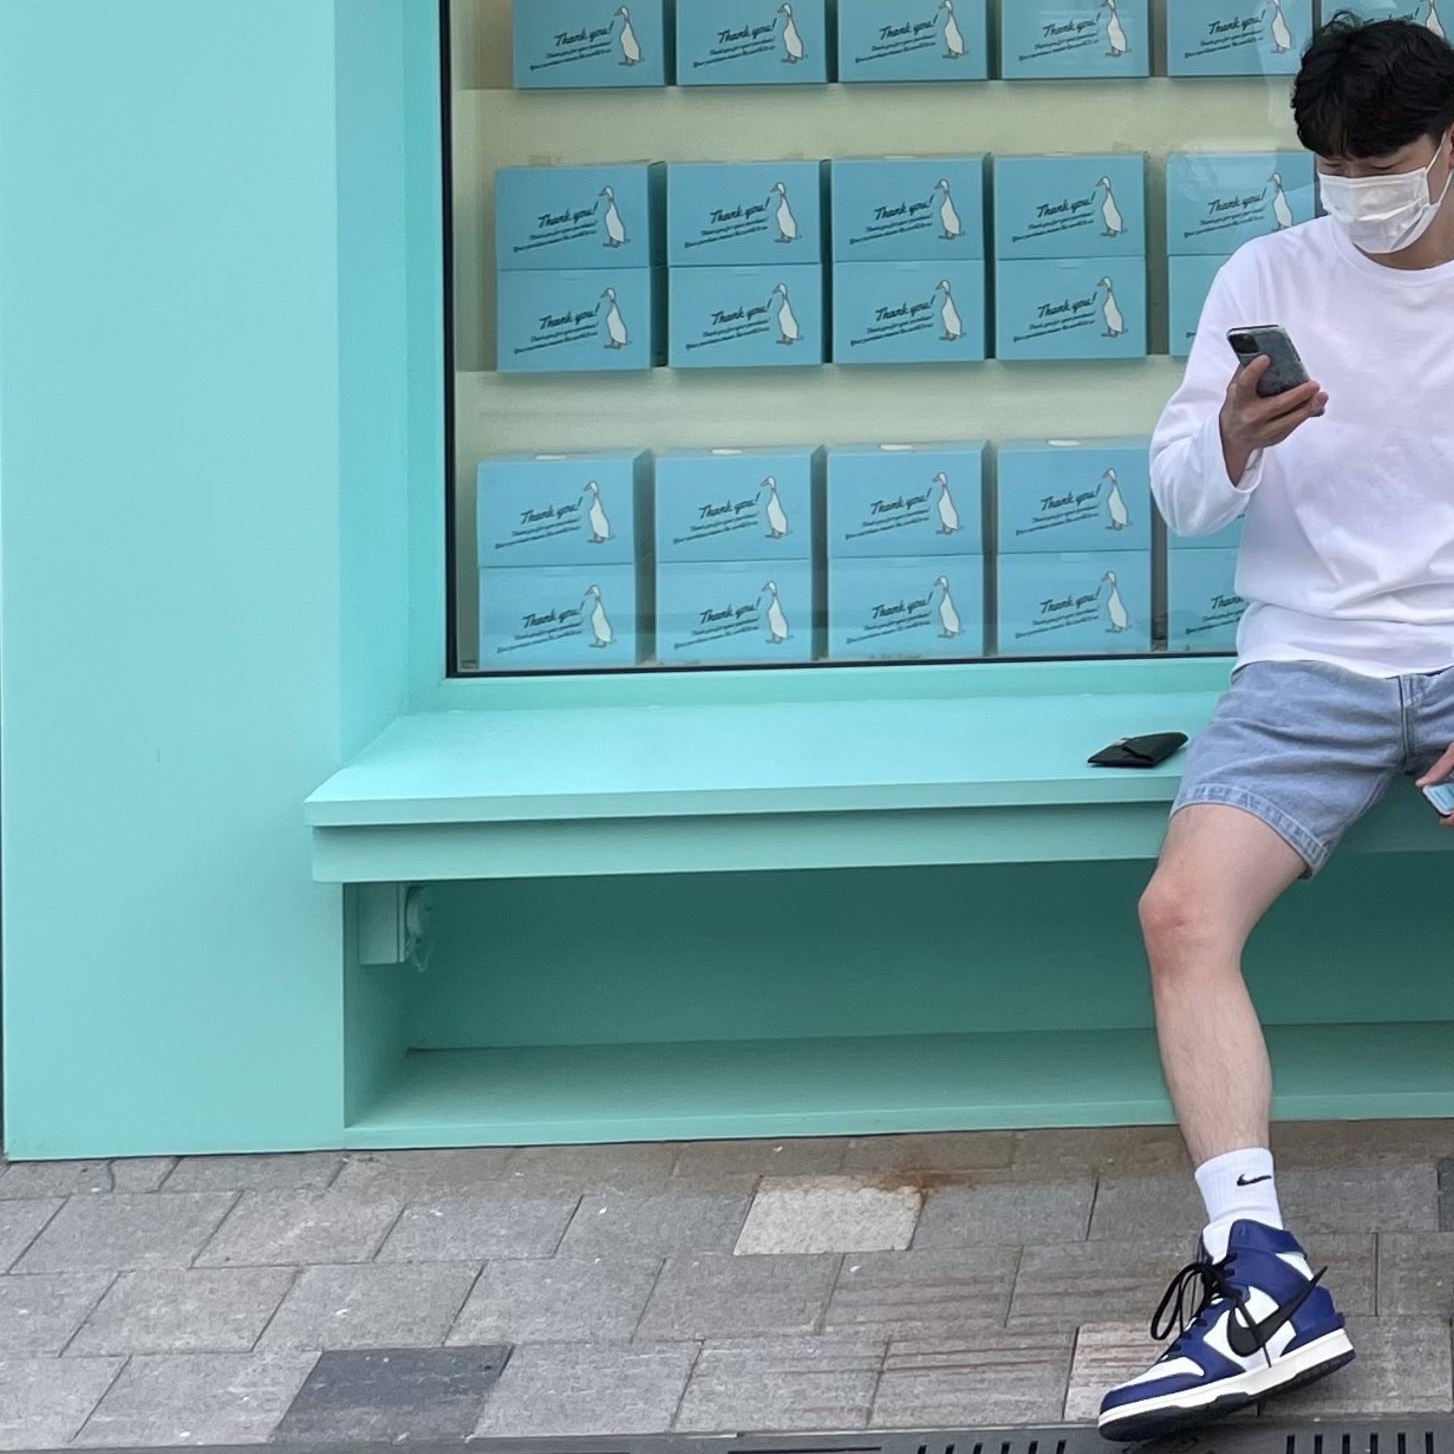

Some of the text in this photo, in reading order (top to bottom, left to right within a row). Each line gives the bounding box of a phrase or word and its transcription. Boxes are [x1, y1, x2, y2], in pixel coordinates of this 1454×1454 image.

[718, 25, 750, 43] Thank
[879, 21, 911, 39] Thank
[1042, 19, 1074, 37] Thank
[1208, 16, 1240, 34] Thank
[554, 28, 587, 46] Thank
[710, 204, 743, 223] Thank
[874, 202, 907, 220] Thank
[1036, 198, 1069, 217] Thank
[1208, 195, 1240, 213] Thank
[538, 209, 571, 228] Thank
[711, 306, 744, 325] Thank
[875, 302, 908, 321] Thank
[1037, 298, 1070, 317] Thank
[540, 310, 573, 329] Thank
[698, 500, 732, 519] Thank
[871, 495, 904, 514] Thank
[1041, 491, 1074, 510] Thank
[520, 504, 554, 524] Thank
[872, 599, 905, 618] Thank
[1040, 594, 1073, 613] Thank
[522, 608, 556, 628] Thank
[699, 604, 733, 624] Thank
